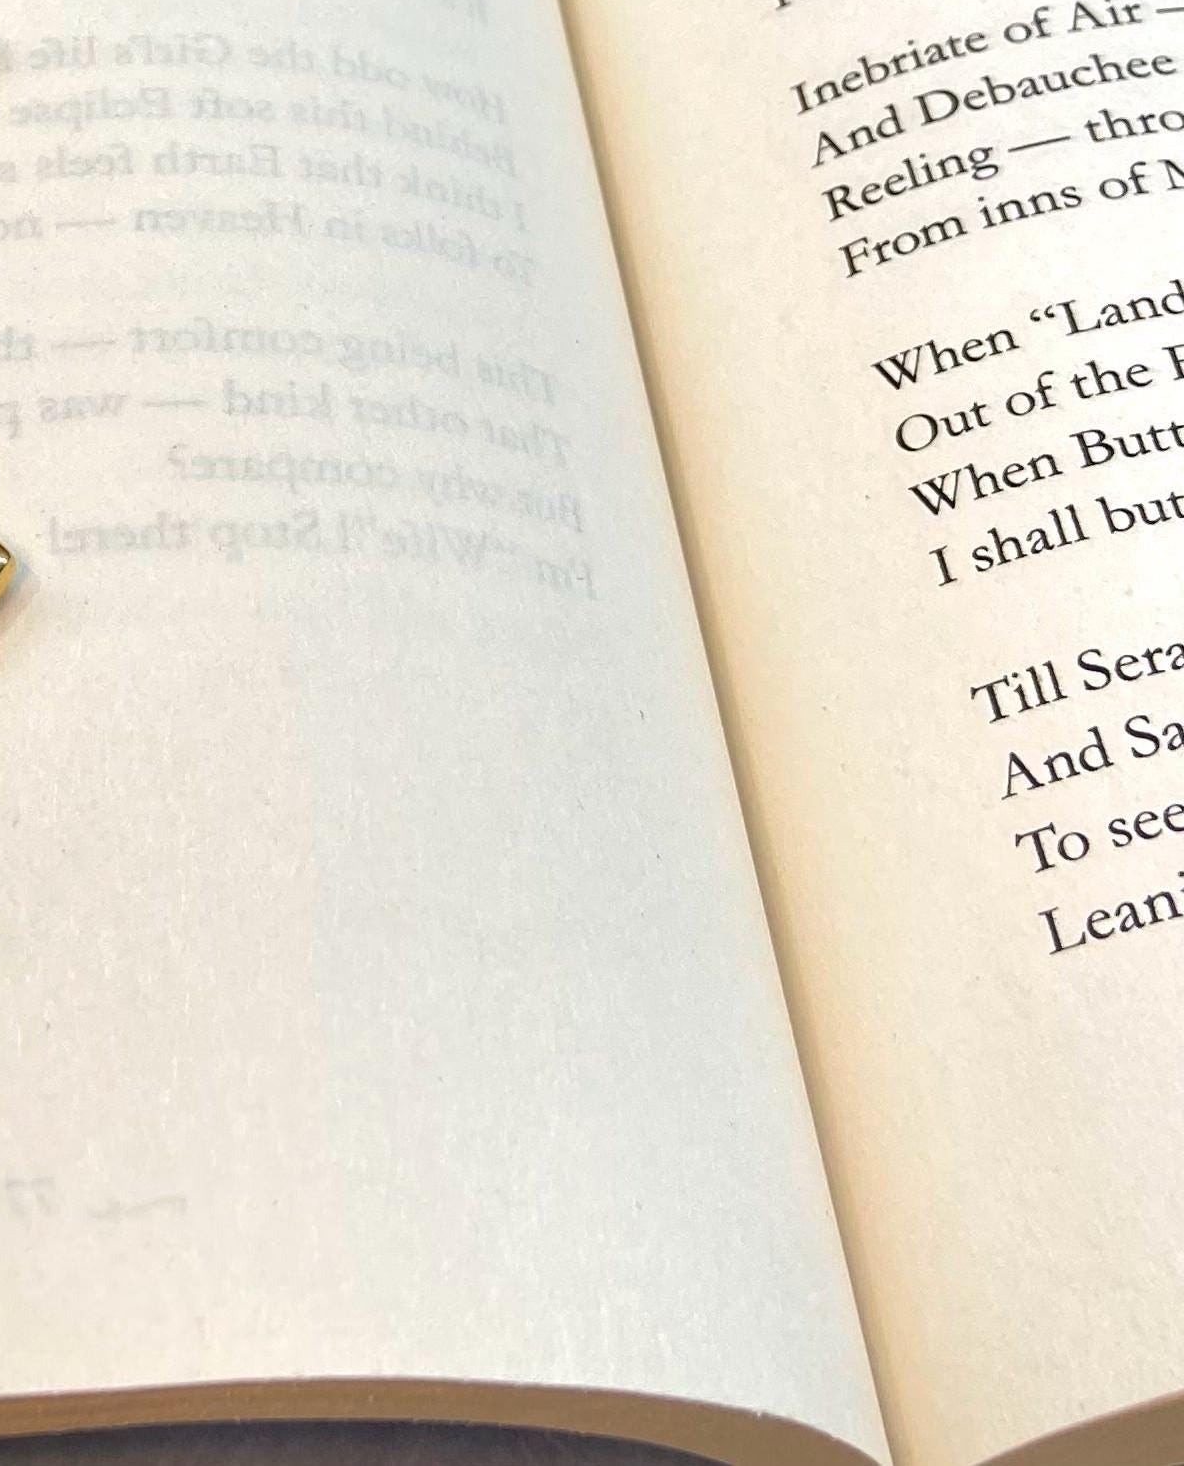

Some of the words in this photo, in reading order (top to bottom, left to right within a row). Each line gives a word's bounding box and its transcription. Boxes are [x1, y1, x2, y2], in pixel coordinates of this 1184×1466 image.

[790, 31, 990, 117] Inebriate
[1002, 5, 1052, 44] of
[810, 103, 907, 170] And
[913, 52, 1178, 128] Debauchee
[820, 144, 1001, 224] Reeling
[837, 213, 969, 279] From
[979, 184, 1083, 231] inns
[1098, 161, 1150, 201] of
[871, 326, 1020, 393] When
[894, 399, 994, 455] Out
[1005, 369, 1057, 416] of
[1069, 359, 1154, 400] the
[908, 452, 1064, 518] When
[929, 545, 957, 588] I
[971, 503, 1090, 573] shall
[970, 659, 1068, 724] Till
[1001, 725, 1114, 800] And
[1014, 821, 1091, 874] To
